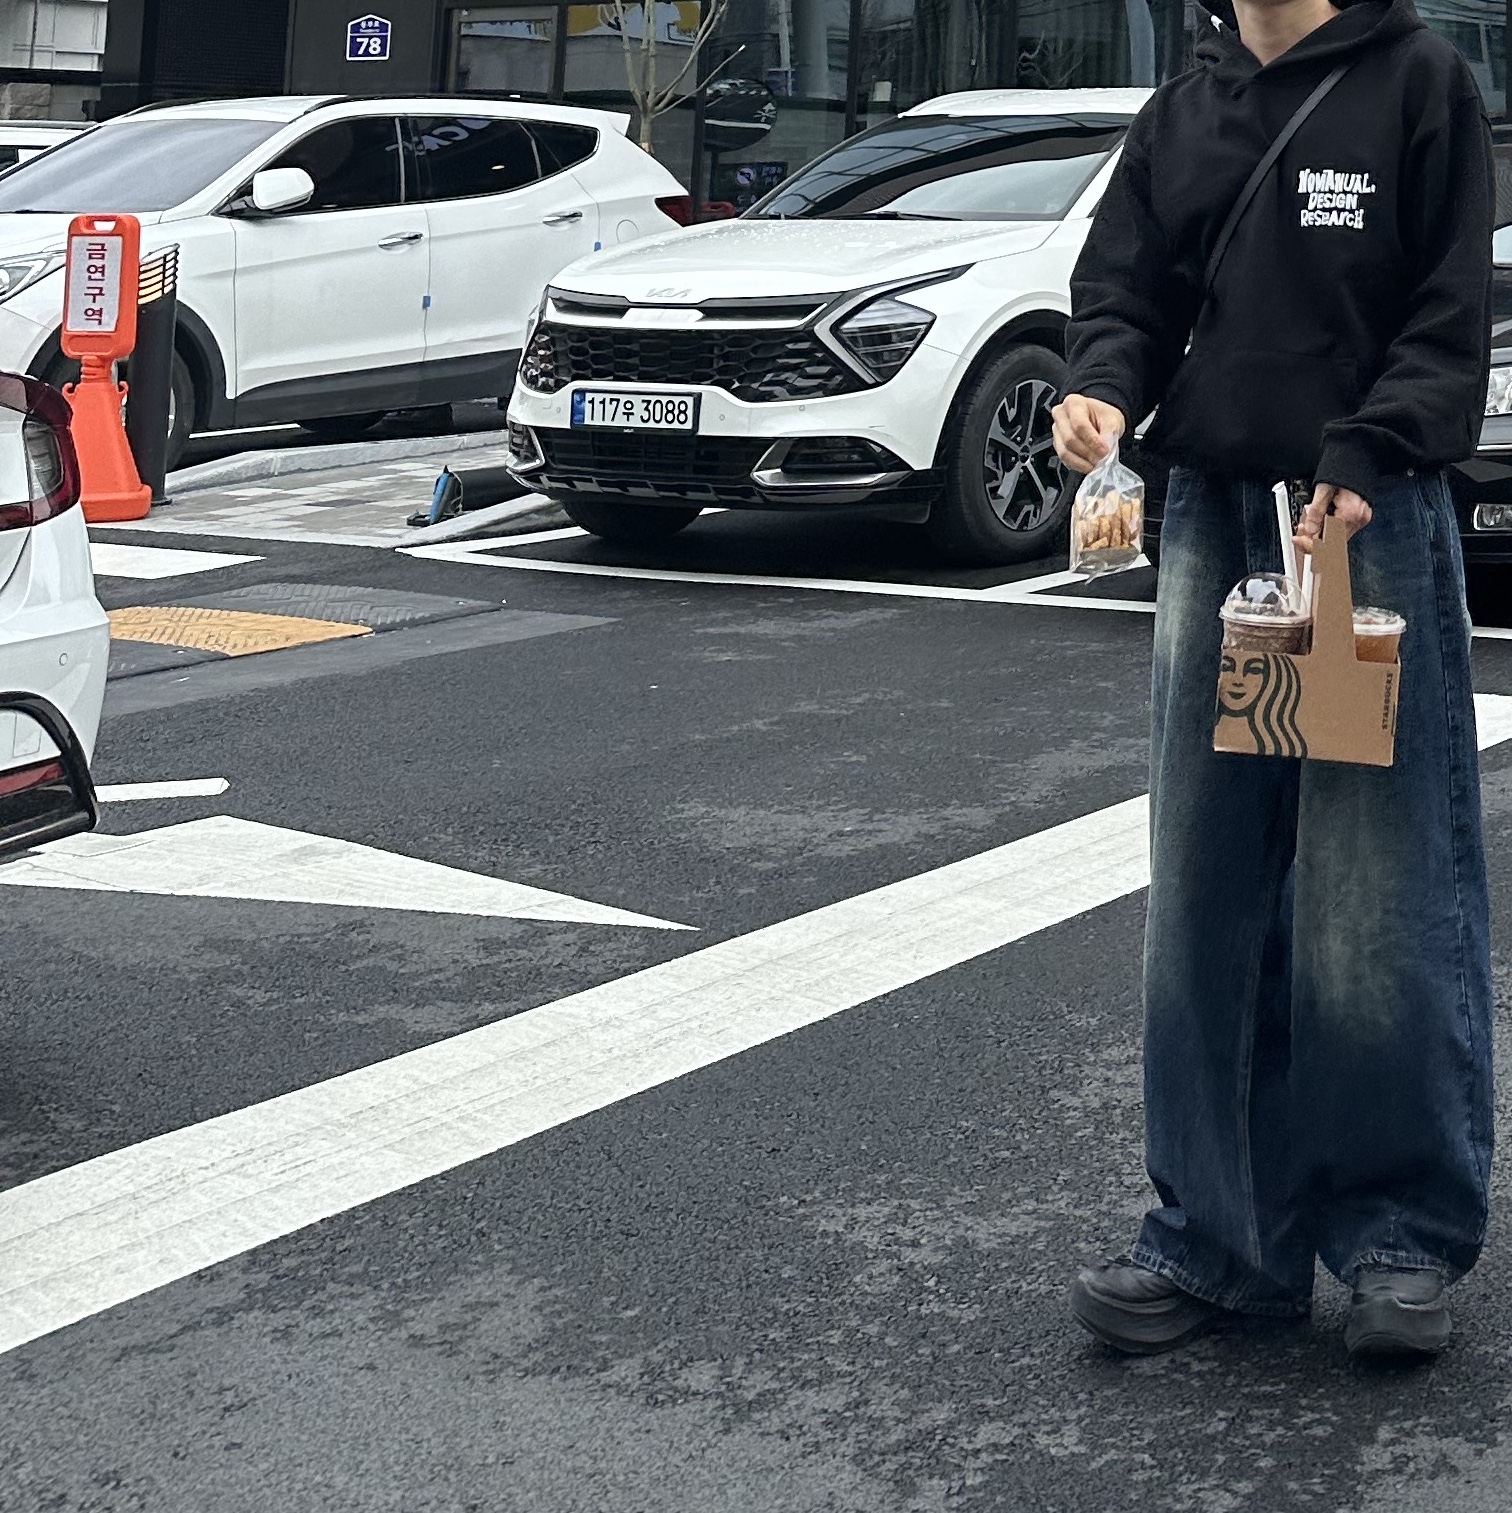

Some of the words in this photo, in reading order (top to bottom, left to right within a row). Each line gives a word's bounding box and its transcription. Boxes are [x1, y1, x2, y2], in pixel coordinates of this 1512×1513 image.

[356, 37, 381, 55] 78
[1308, 192, 1359, 210] DESIGN
[83, 242, 108, 326] 금연구역
[587, 396, 635, 423] 117우
[639, 398, 689, 425] 3088
